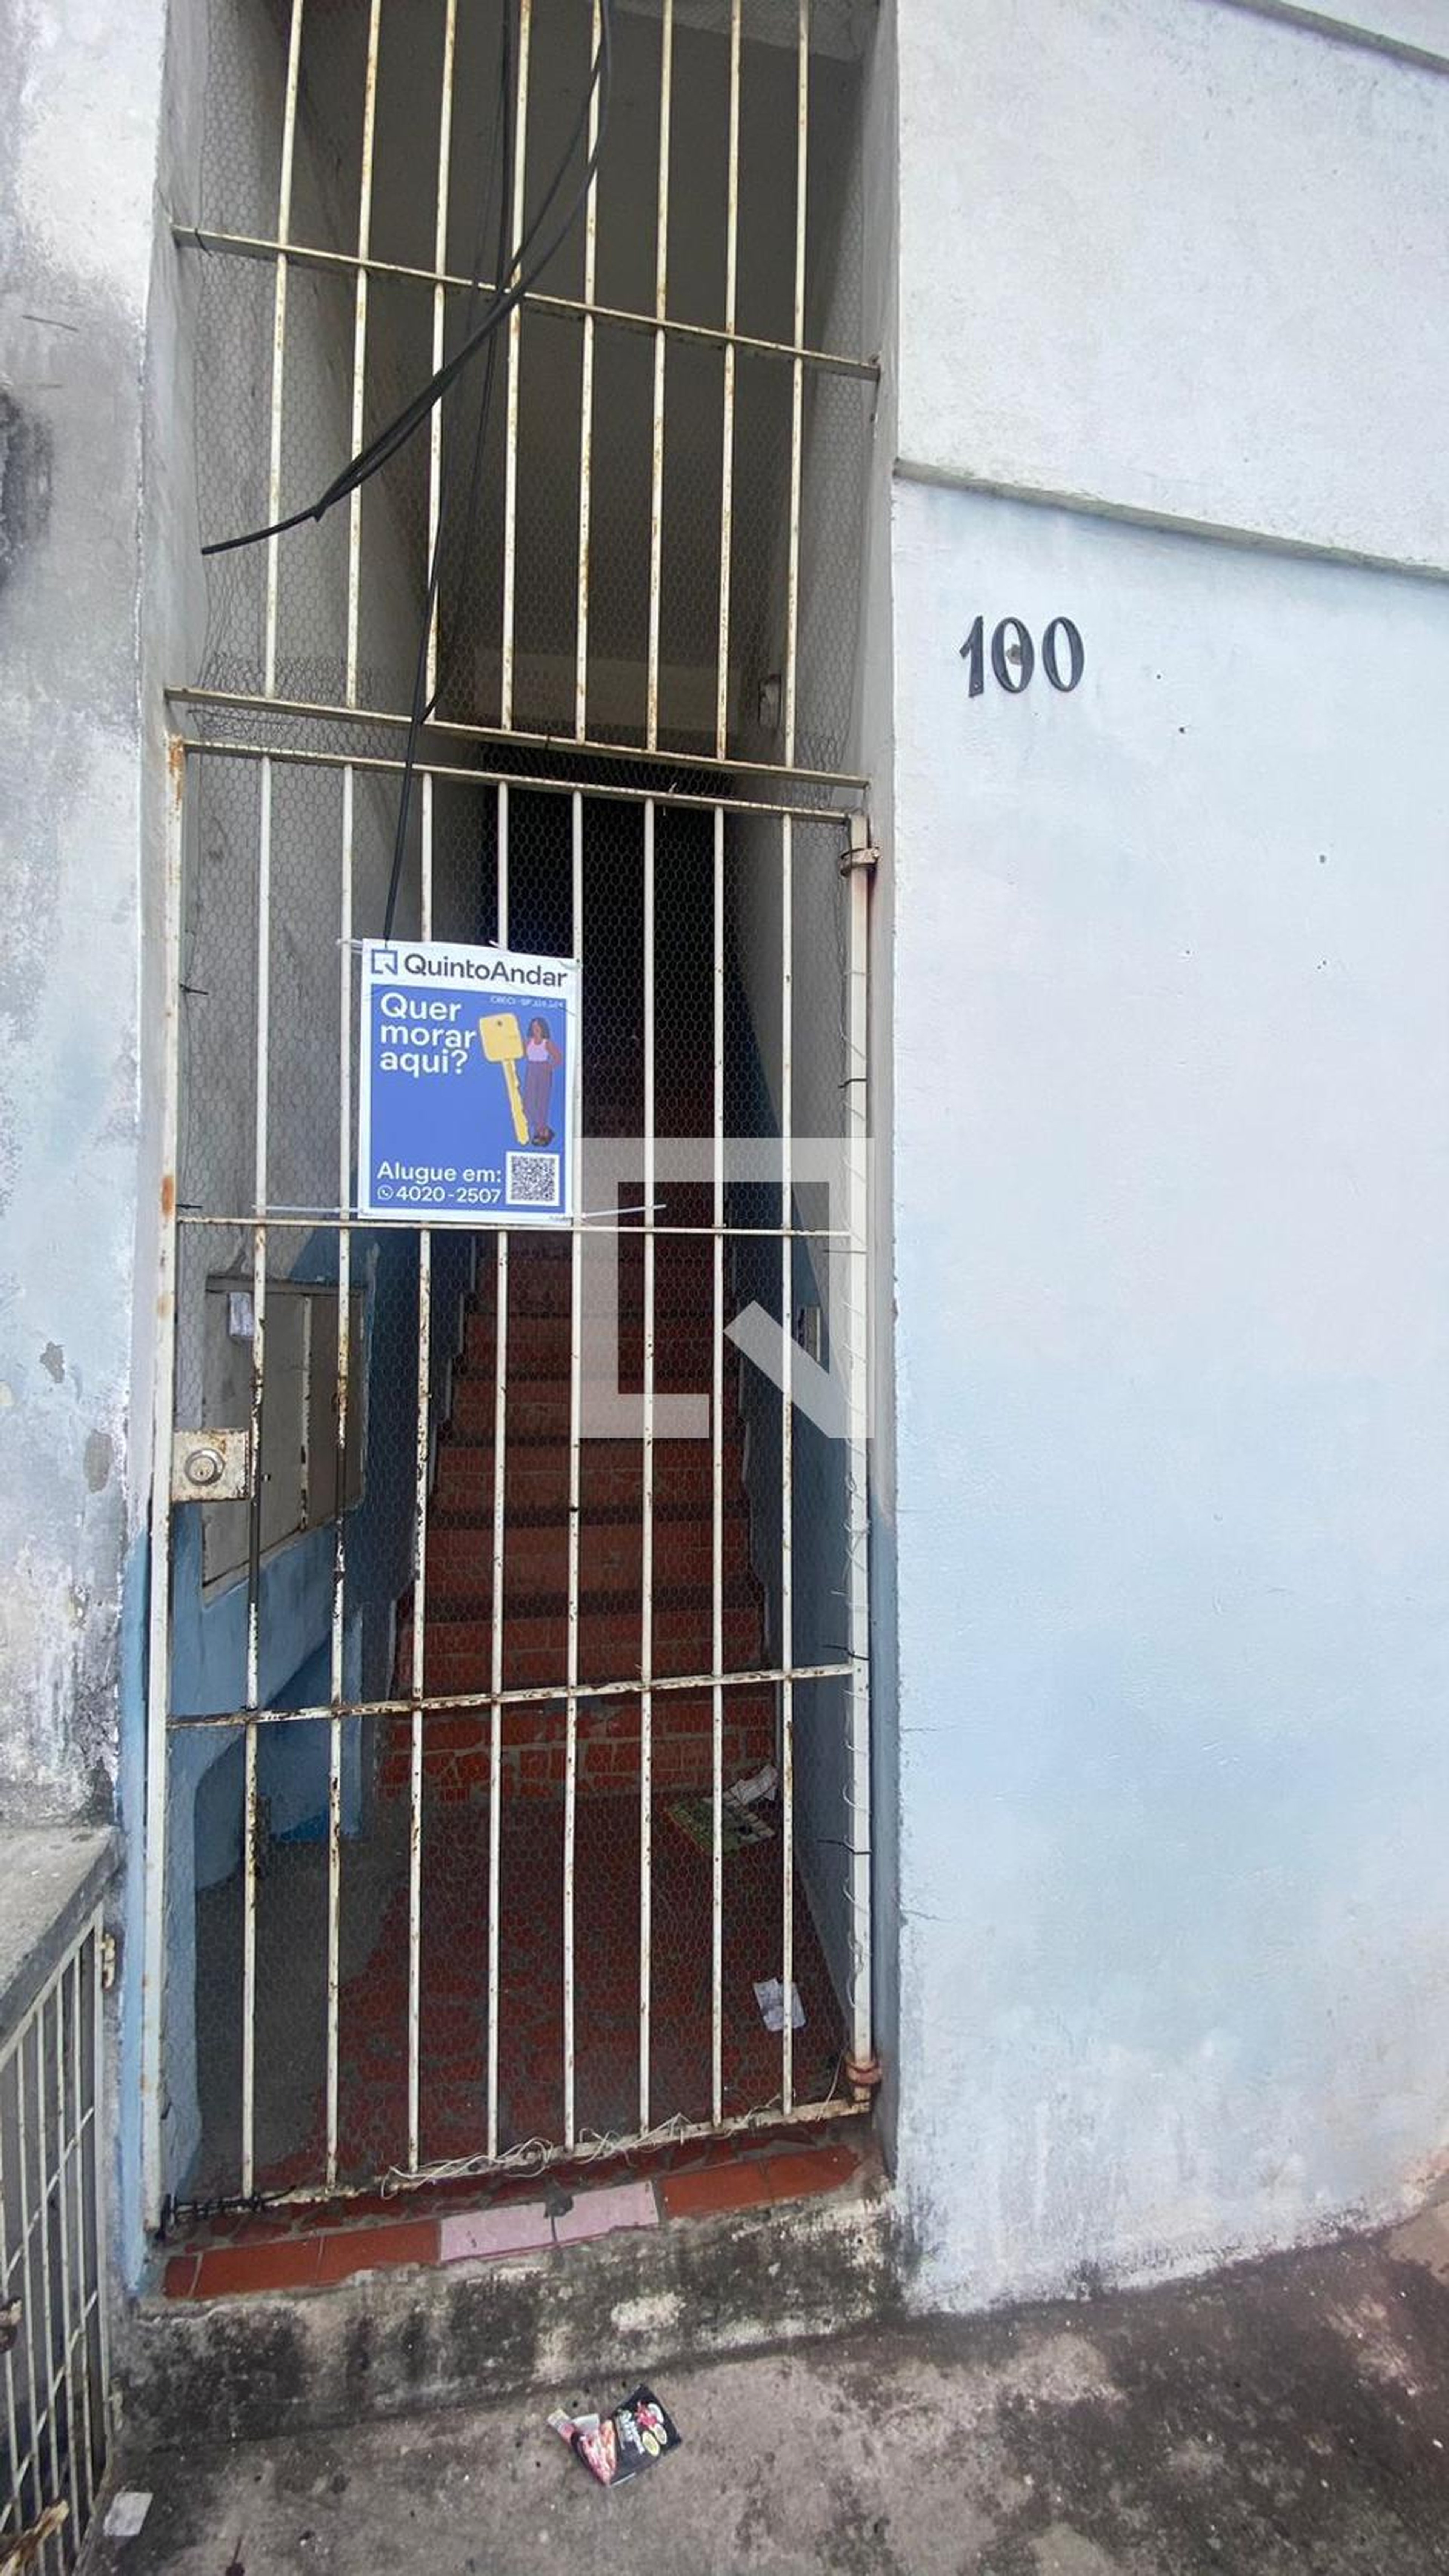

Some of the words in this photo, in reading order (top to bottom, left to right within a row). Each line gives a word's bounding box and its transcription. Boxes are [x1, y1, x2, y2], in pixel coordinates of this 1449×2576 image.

[959, 615, 1084, 698] 100
[404, 953, 567, 987] QuintoAndar
[381, 992, 461, 1021] Quer
[381, 1024, 477, 1048] morar
[380, 1049, 468, 1078] aqui?
[377, 1161, 457, 1184] Alugue
[463, 1169, 502, 1183] em:
